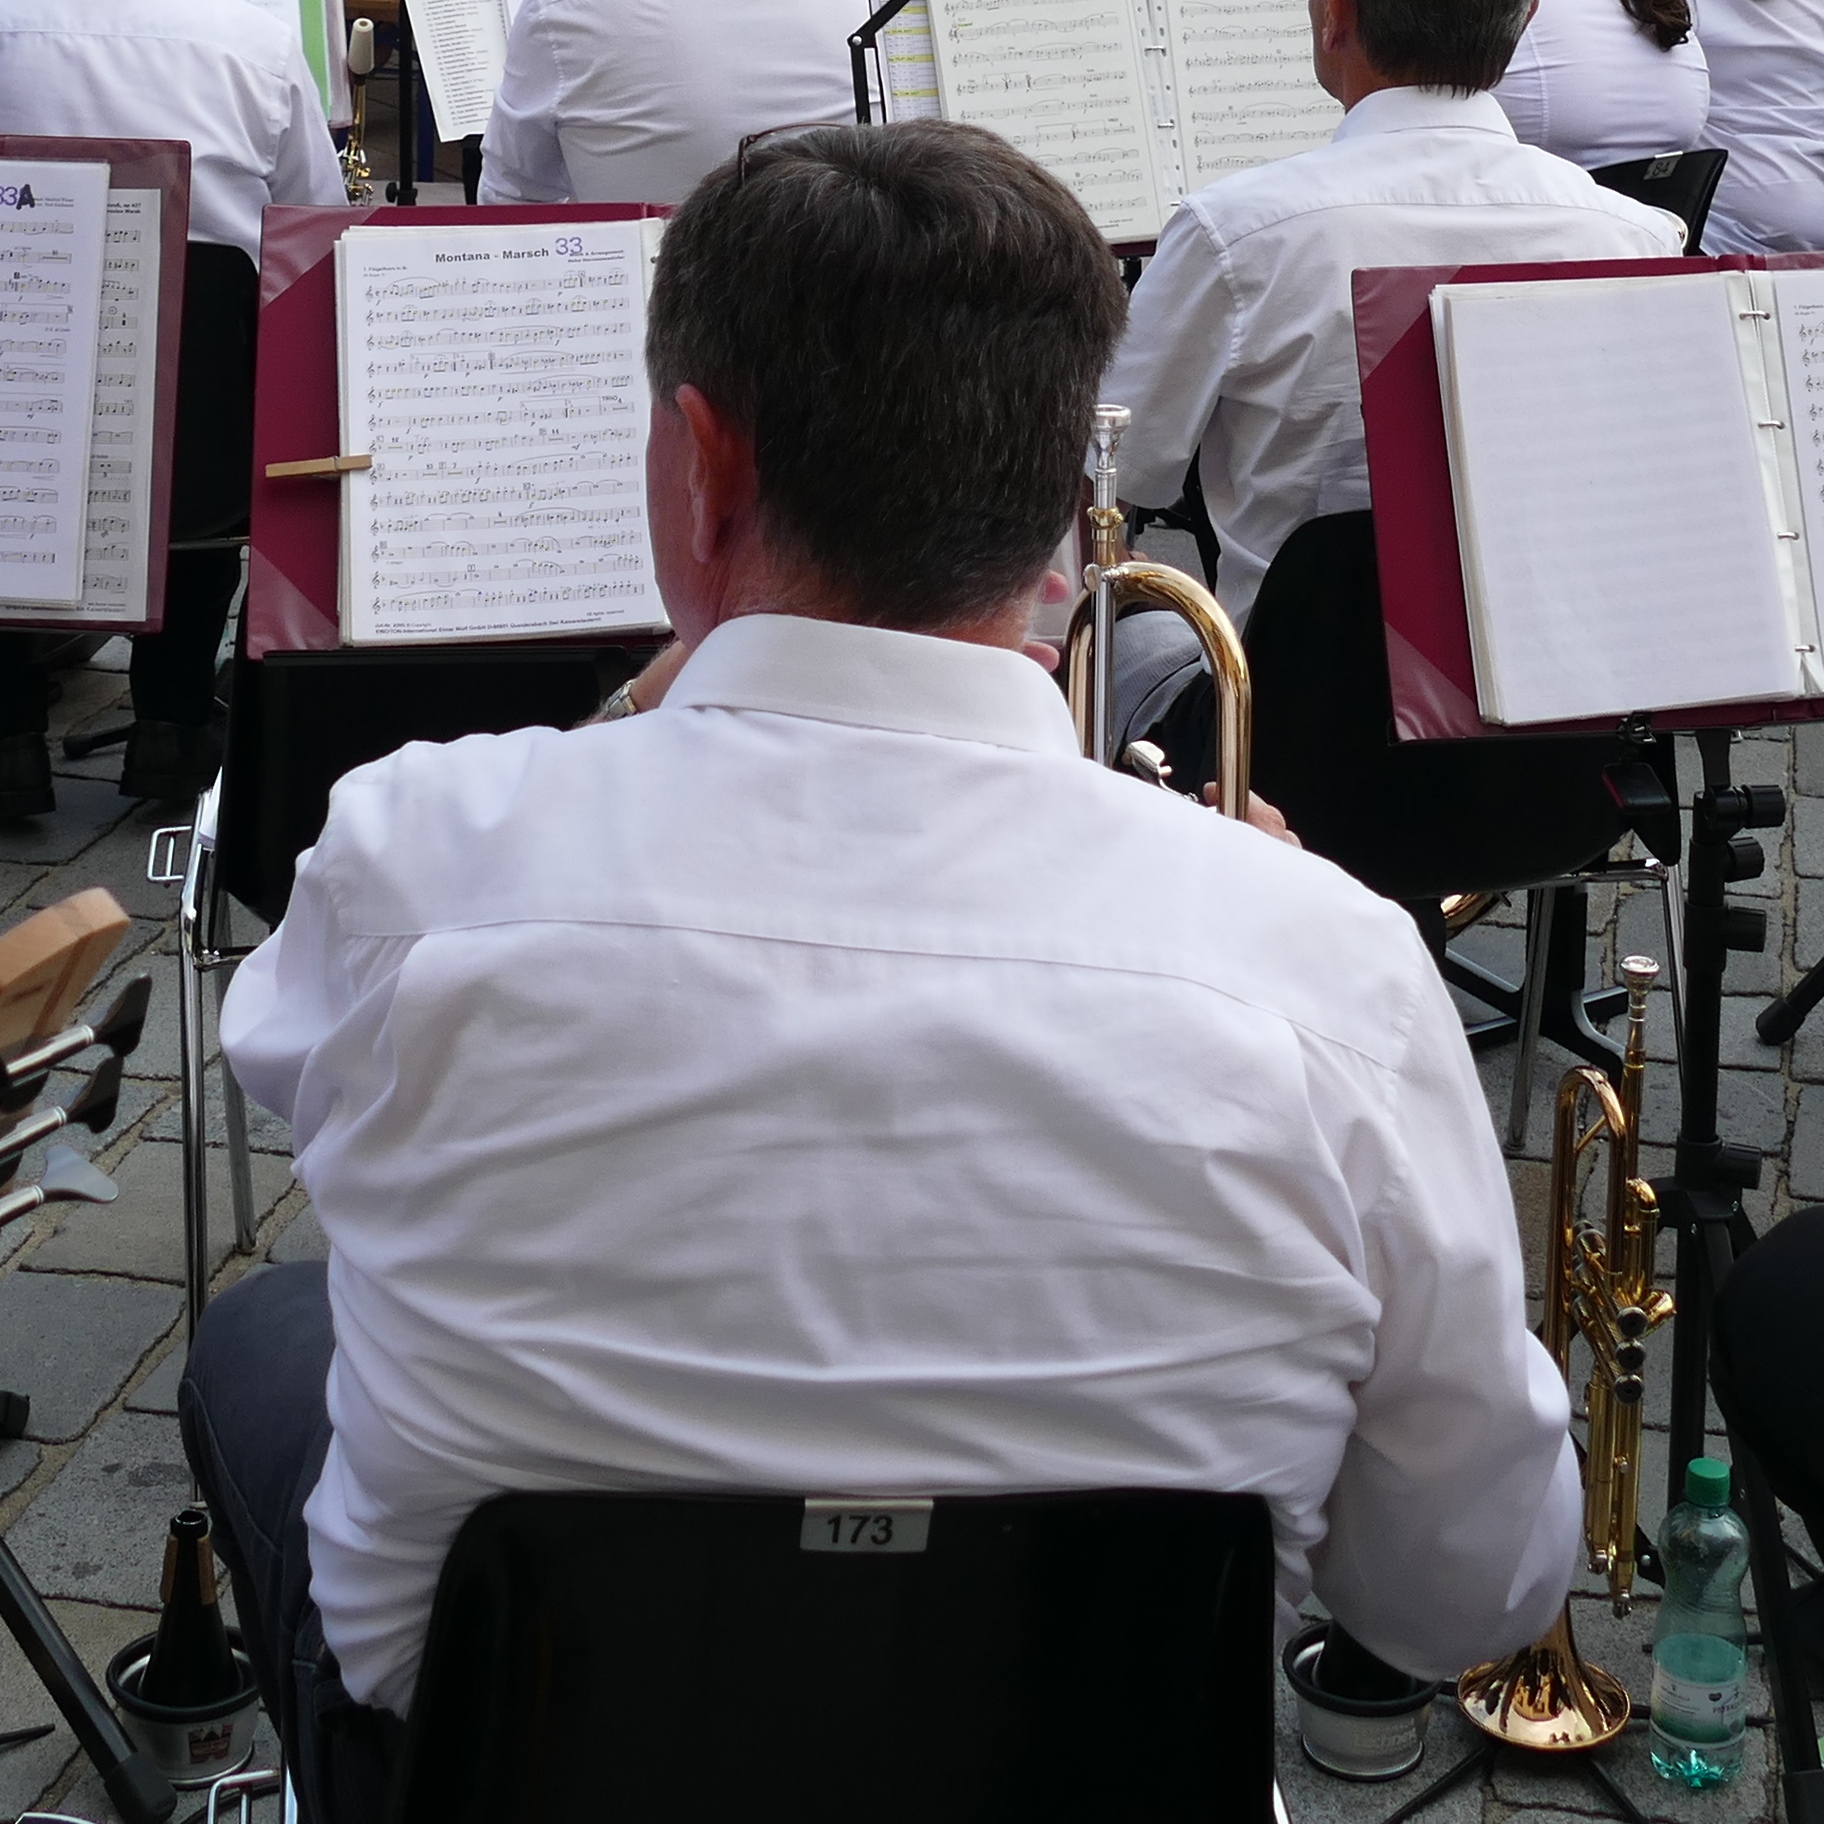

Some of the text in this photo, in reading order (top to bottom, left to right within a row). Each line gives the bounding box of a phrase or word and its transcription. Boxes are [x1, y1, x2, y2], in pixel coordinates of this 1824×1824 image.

[436, 248, 549, 263] Montana Marsch
[555, 237, 583, 256] 33
[826, 1514, 894, 1545] 173
